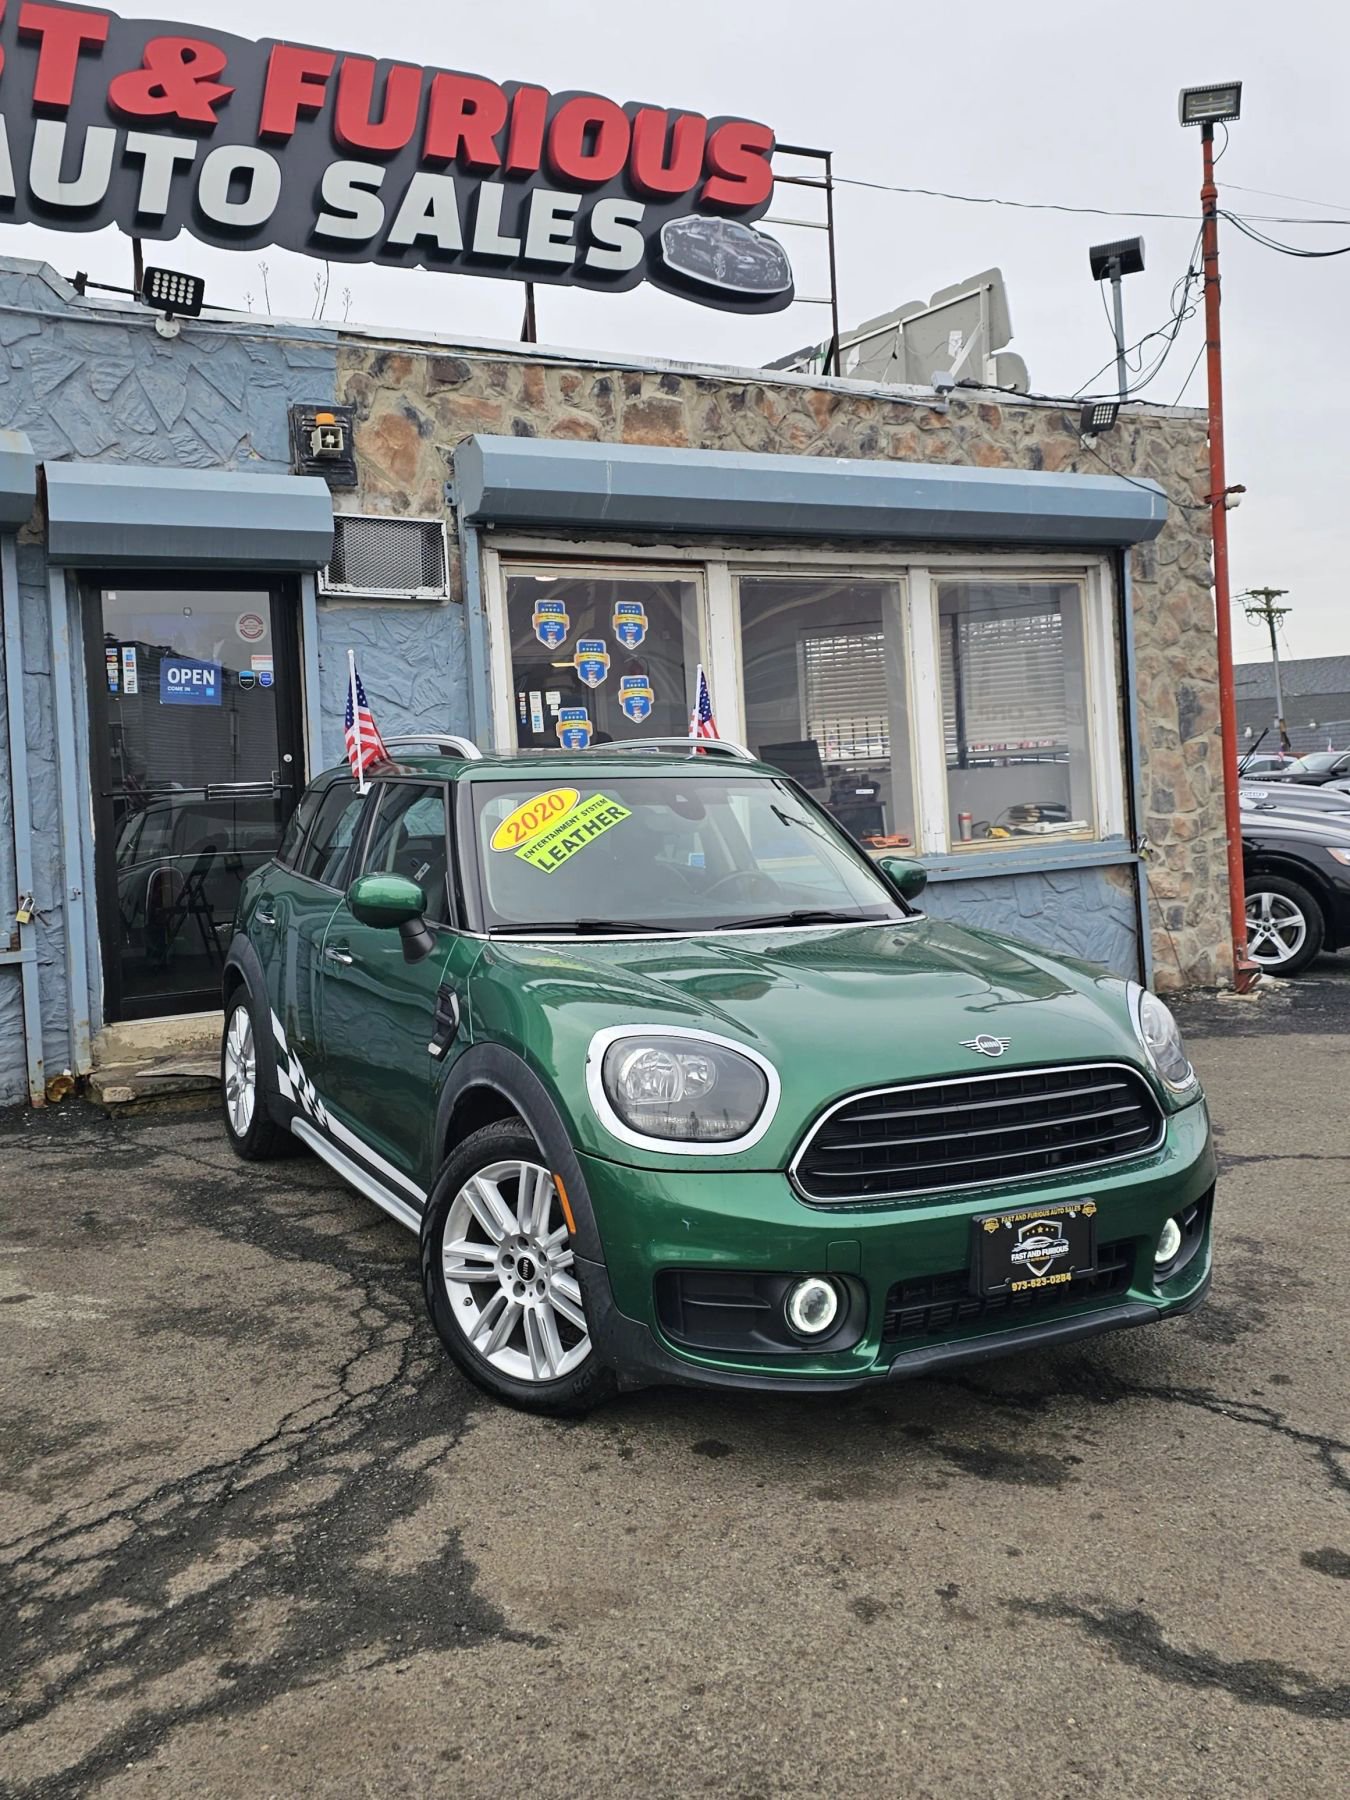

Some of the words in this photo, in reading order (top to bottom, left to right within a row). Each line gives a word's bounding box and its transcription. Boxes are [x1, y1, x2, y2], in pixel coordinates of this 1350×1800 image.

[107, 35, 237, 136] &
[258, 43, 775, 206] FURIOUS
[0, 112, 282, 227] UTO
[313, 159, 646, 272] SALES
[167, 667, 215, 685] OPEN
[506, 793, 565, 843] 2020
[523, 814, 581, 860] ENTERTAINMENT
[580, 798, 608, 817] SYSTEM
[537, 805, 626, 872] LEATHER
[1001, 1215, 1015, 1224] FAST
[1014, 1213, 1027, 1222] AND
[1010, 1251, 1028, 1262] FAST
[1026, 1249, 1042, 1258] AND
[1041, 1245, 1069, 1256] FURIOUS
